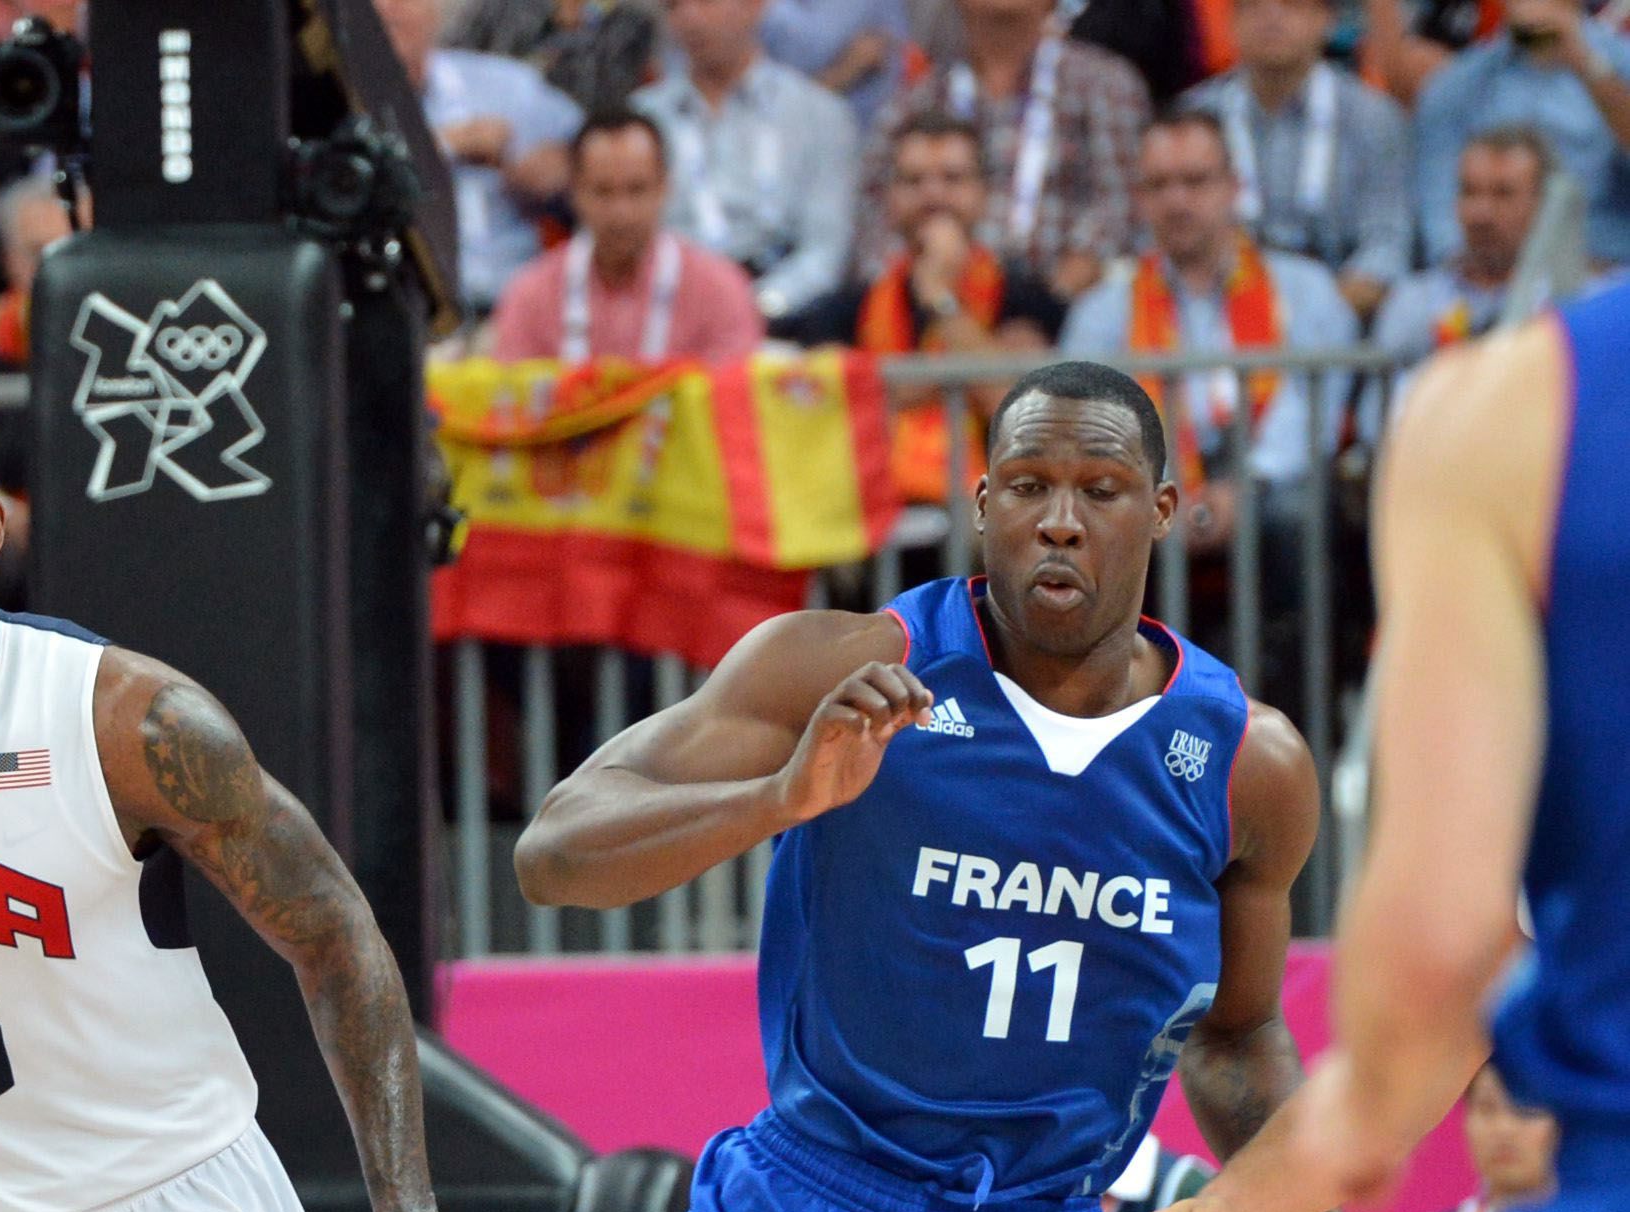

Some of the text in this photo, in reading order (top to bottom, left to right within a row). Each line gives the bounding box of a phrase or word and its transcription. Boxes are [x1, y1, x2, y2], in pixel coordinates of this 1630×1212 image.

[1169, 729, 1212, 764] FRANCE
[912, 846, 1174, 934] FRANCE
[964, 937, 1084, 1042] 11
